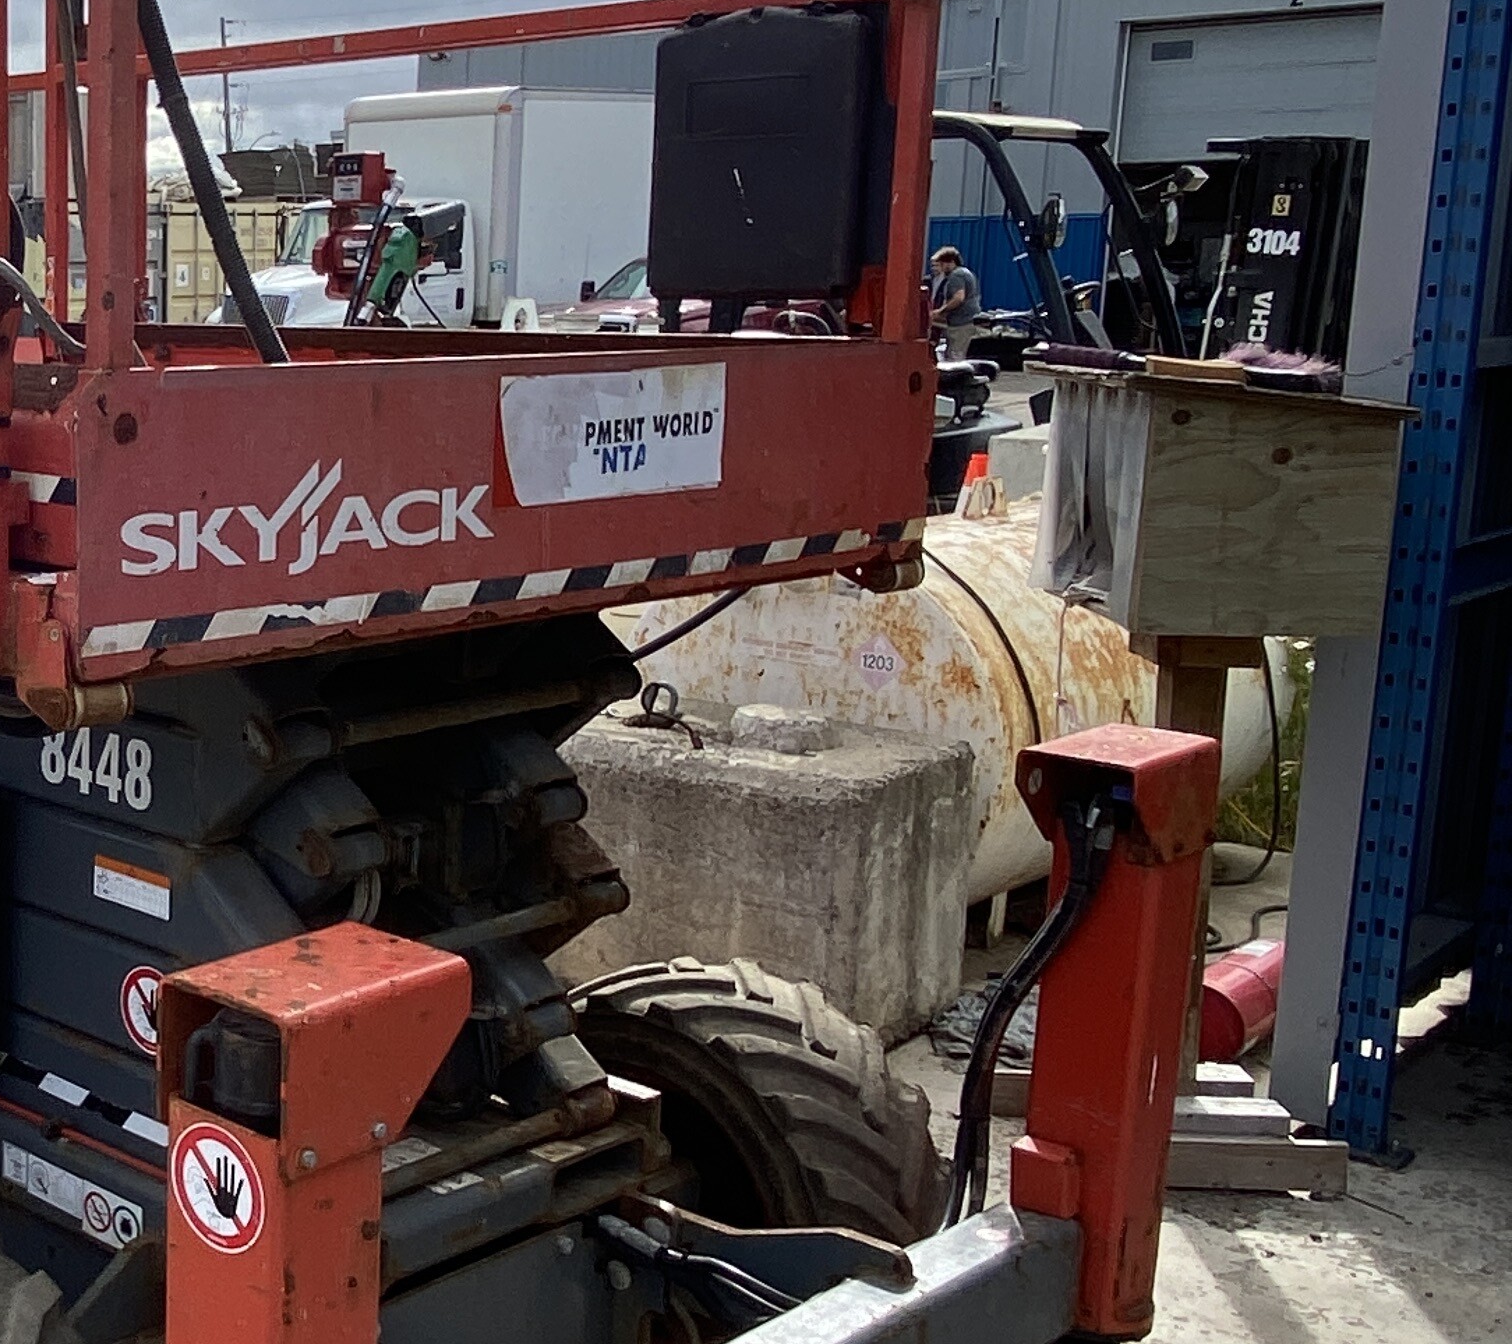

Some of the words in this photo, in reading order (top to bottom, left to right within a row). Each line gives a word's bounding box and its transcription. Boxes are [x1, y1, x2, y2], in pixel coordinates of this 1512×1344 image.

[1246, 227, 1301, 256] 3104
[1248, 291, 1274, 342] CHA
[593, 442, 646, 474] NTA
[120, 458, 494, 576] SKYJACK
[862, 653, 894, 673] 1203
[41, 726, 152, 810] 8448
